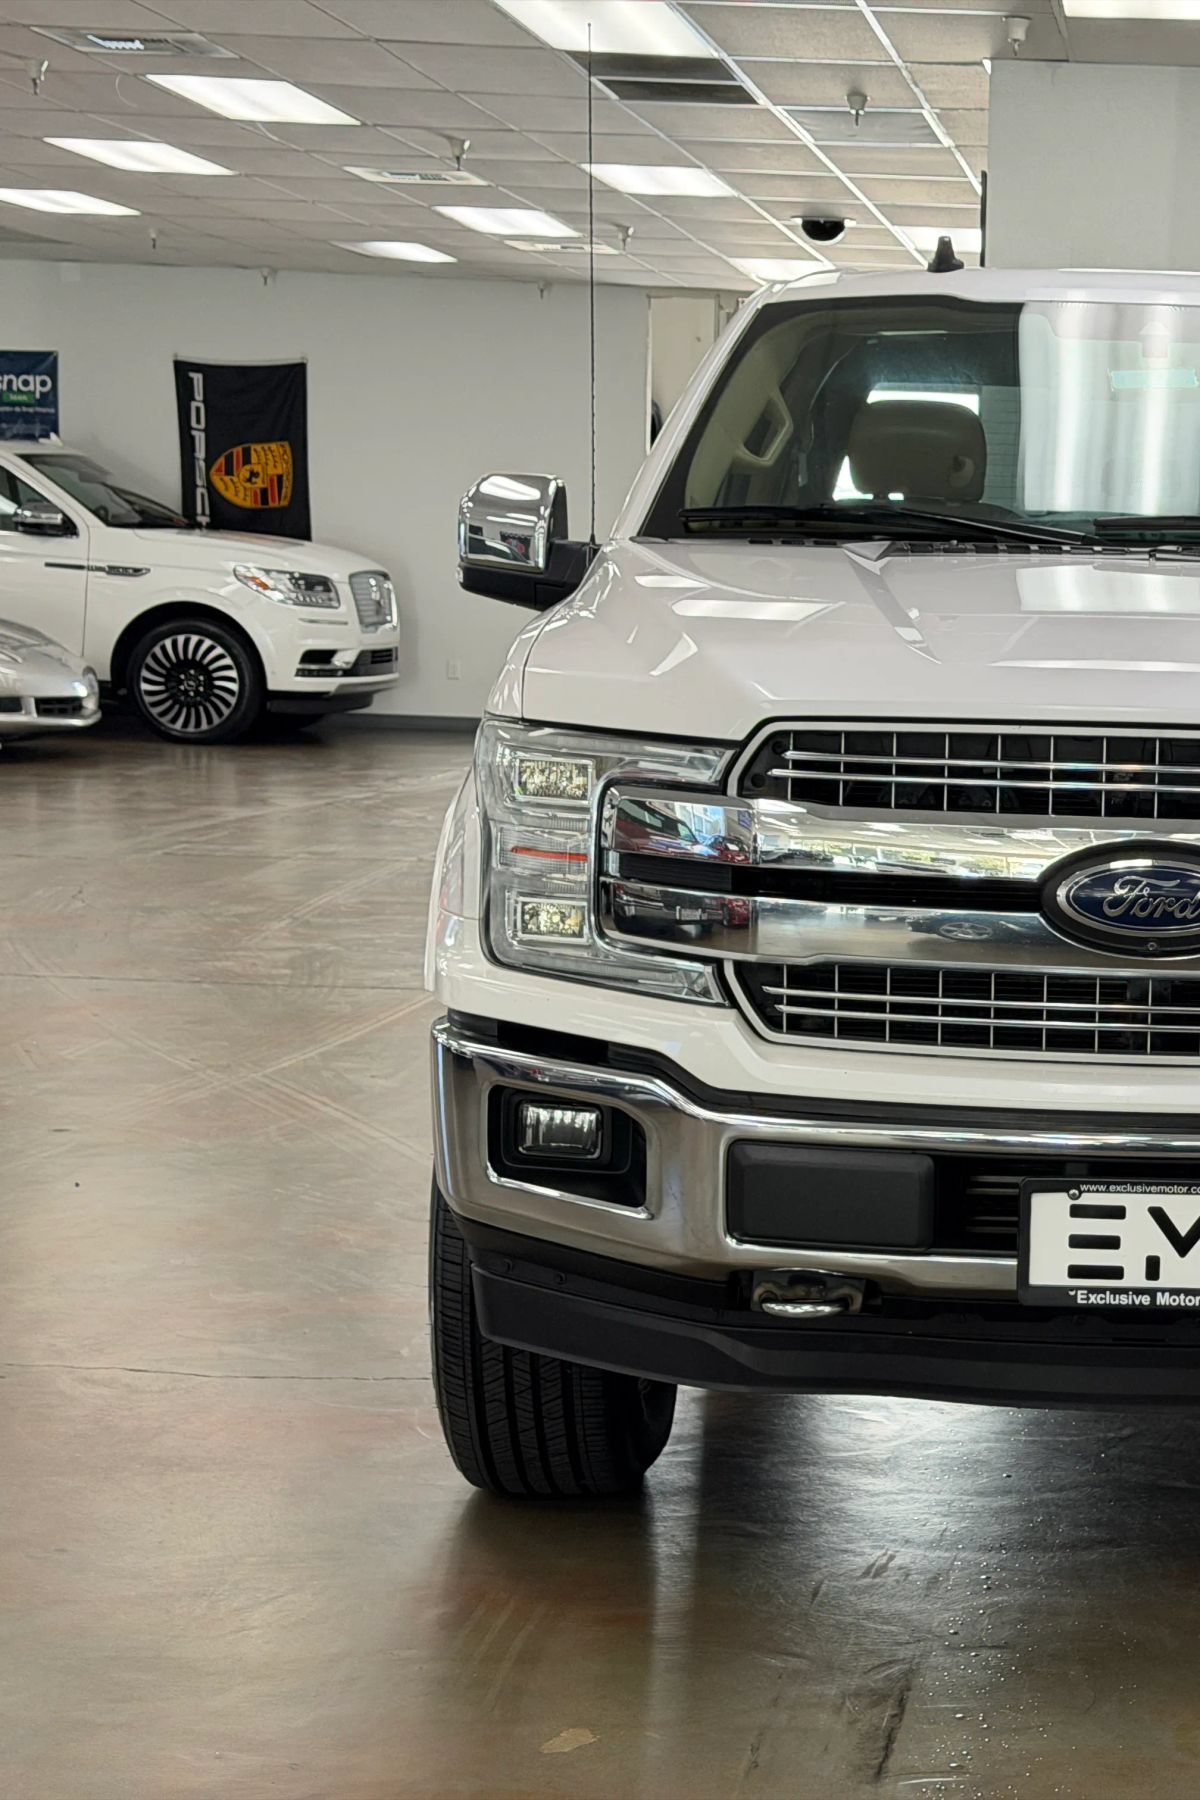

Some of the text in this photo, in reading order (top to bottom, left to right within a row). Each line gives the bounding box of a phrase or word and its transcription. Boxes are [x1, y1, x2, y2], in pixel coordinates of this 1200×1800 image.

[0, 374, 52, 400] nap
[188, 371, 210, 527] PORSC
[1076, 1290, 1151, 1306] Exclusive
